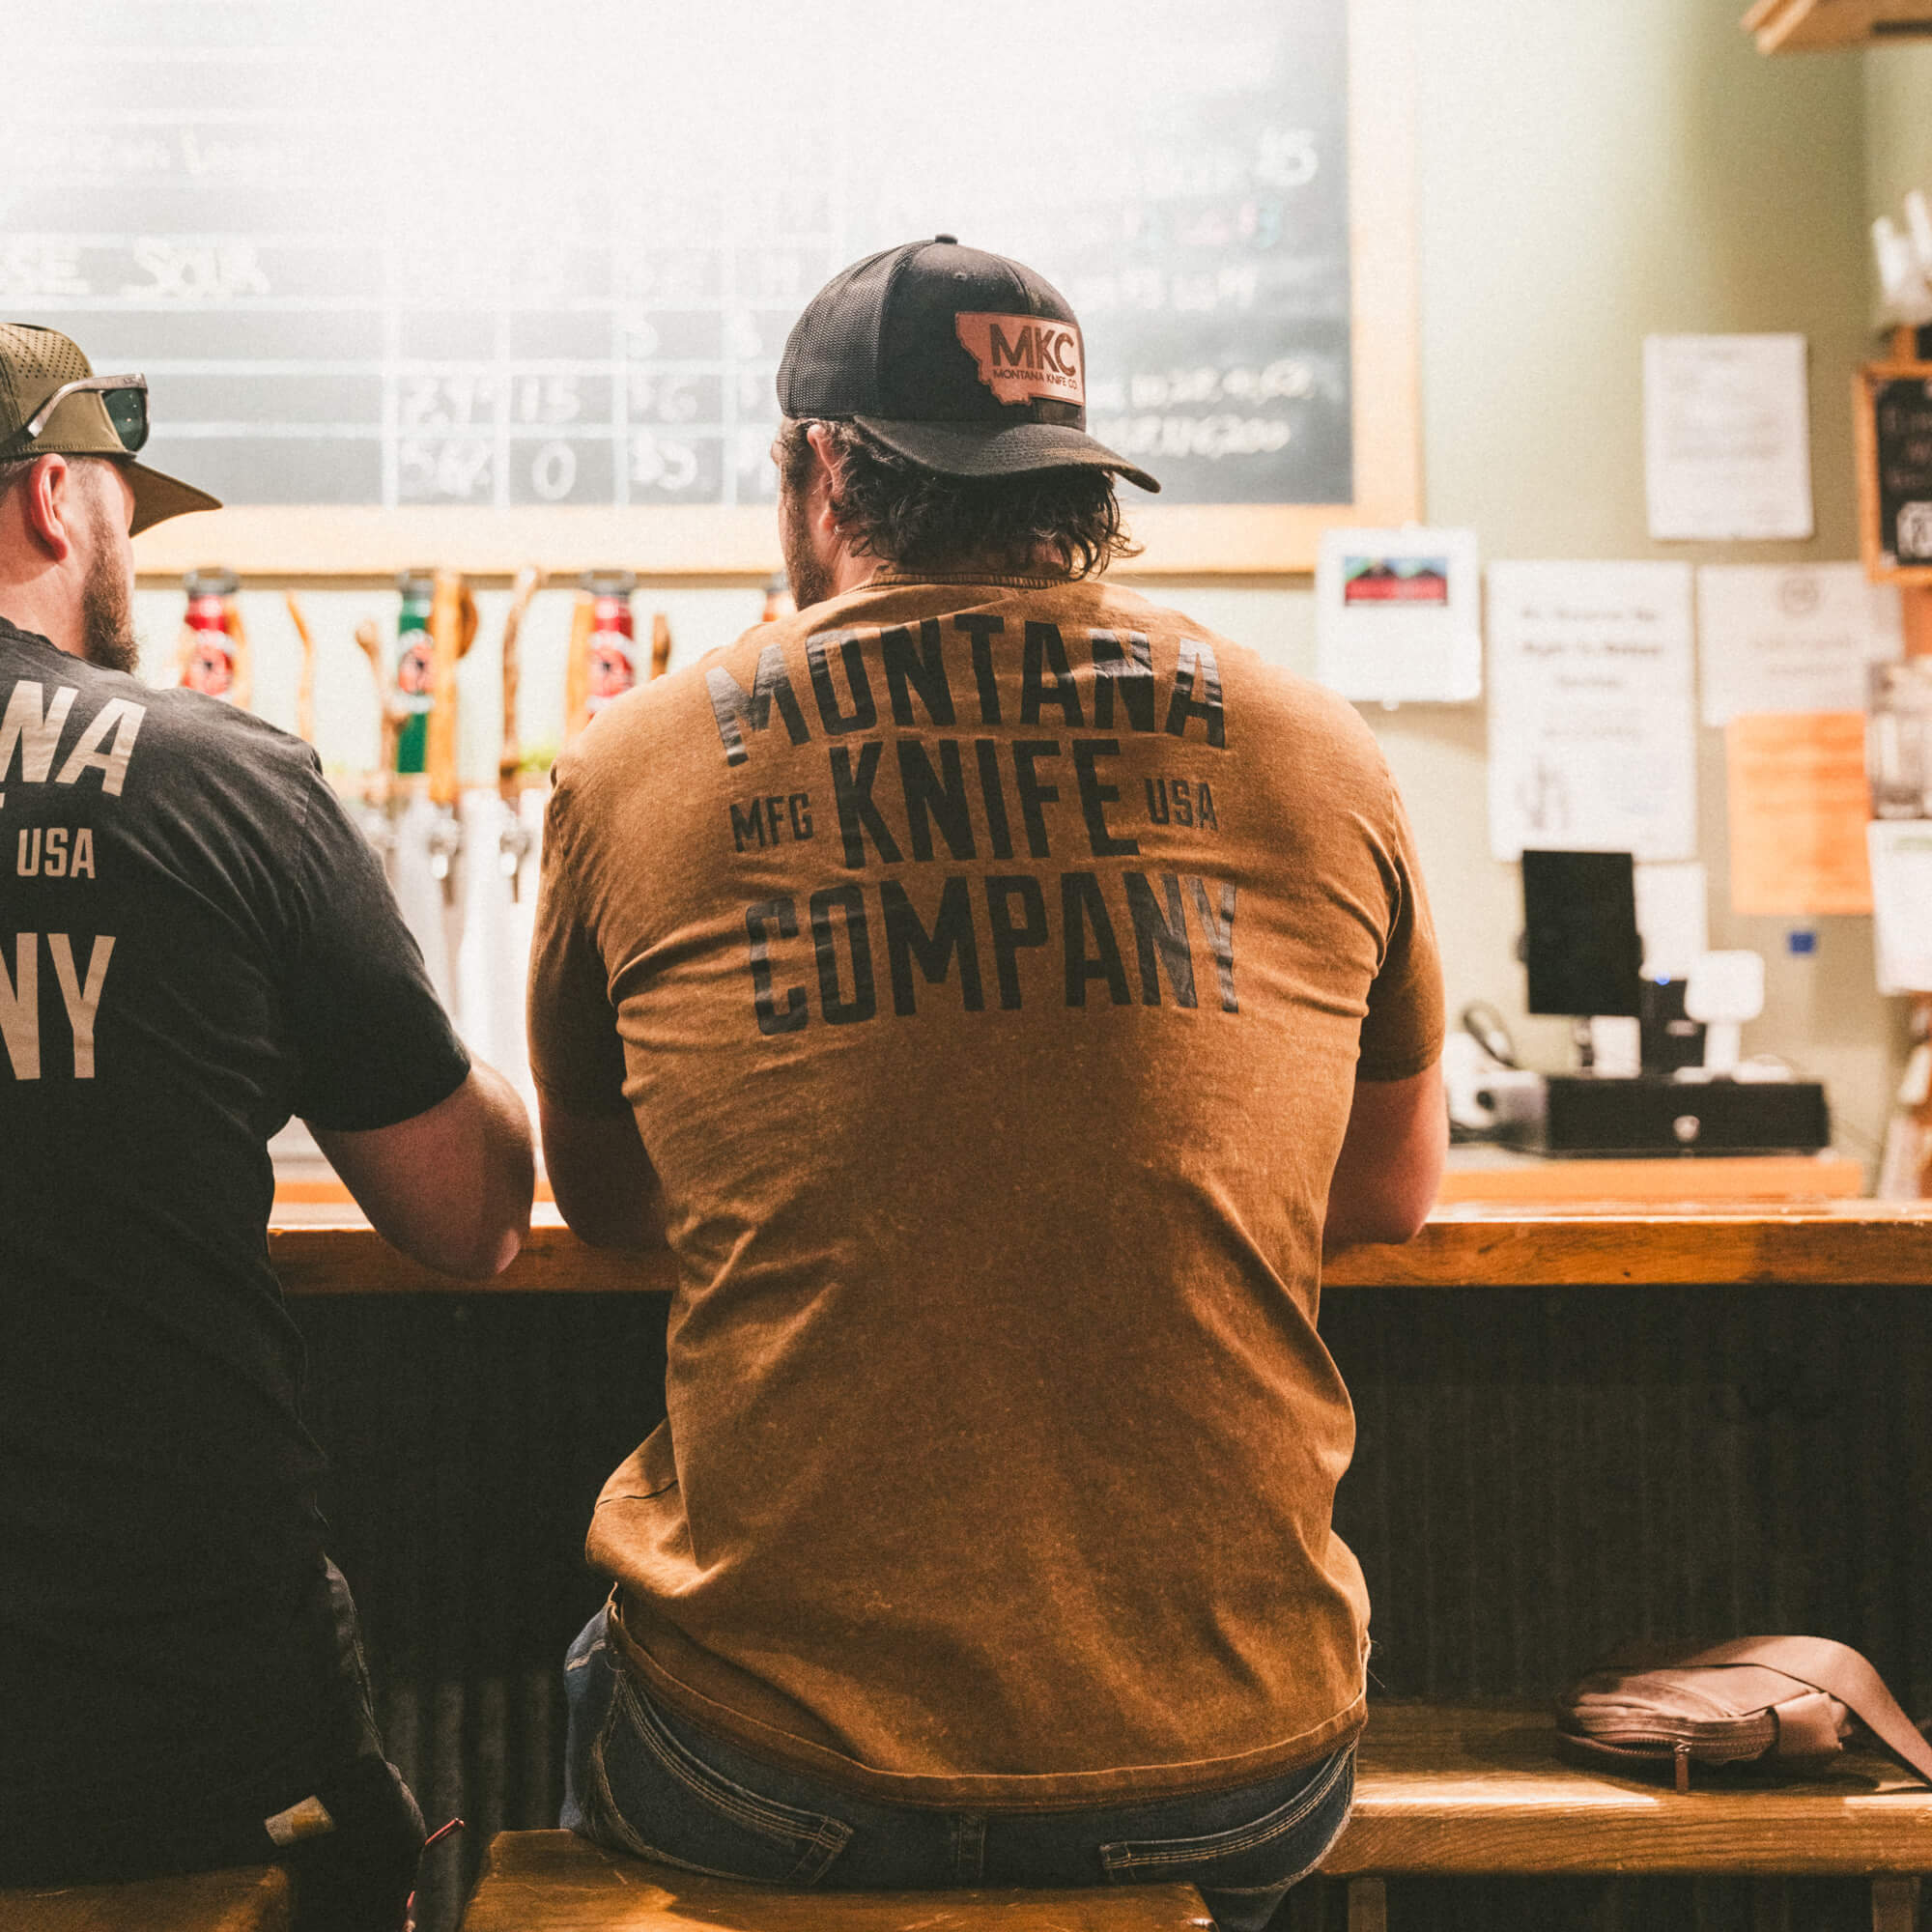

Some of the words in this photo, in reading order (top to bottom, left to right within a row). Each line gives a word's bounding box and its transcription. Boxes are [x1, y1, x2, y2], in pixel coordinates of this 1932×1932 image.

[990, 323, 1075, 377] MKC
[993, 369, 1043, 381] MONTANA
[1046, 373, 1066, 386] KNIFE
[704, 613, 1226, 766] MONTANA
[729, 792, 813, 852] MFG
[830, 739, 1140, 868] KNIFE
[1146, 778, 1218, 831] USA
[17, 827, 95, 878] USA
[745, 871, 1239, 1036] COMPANY
